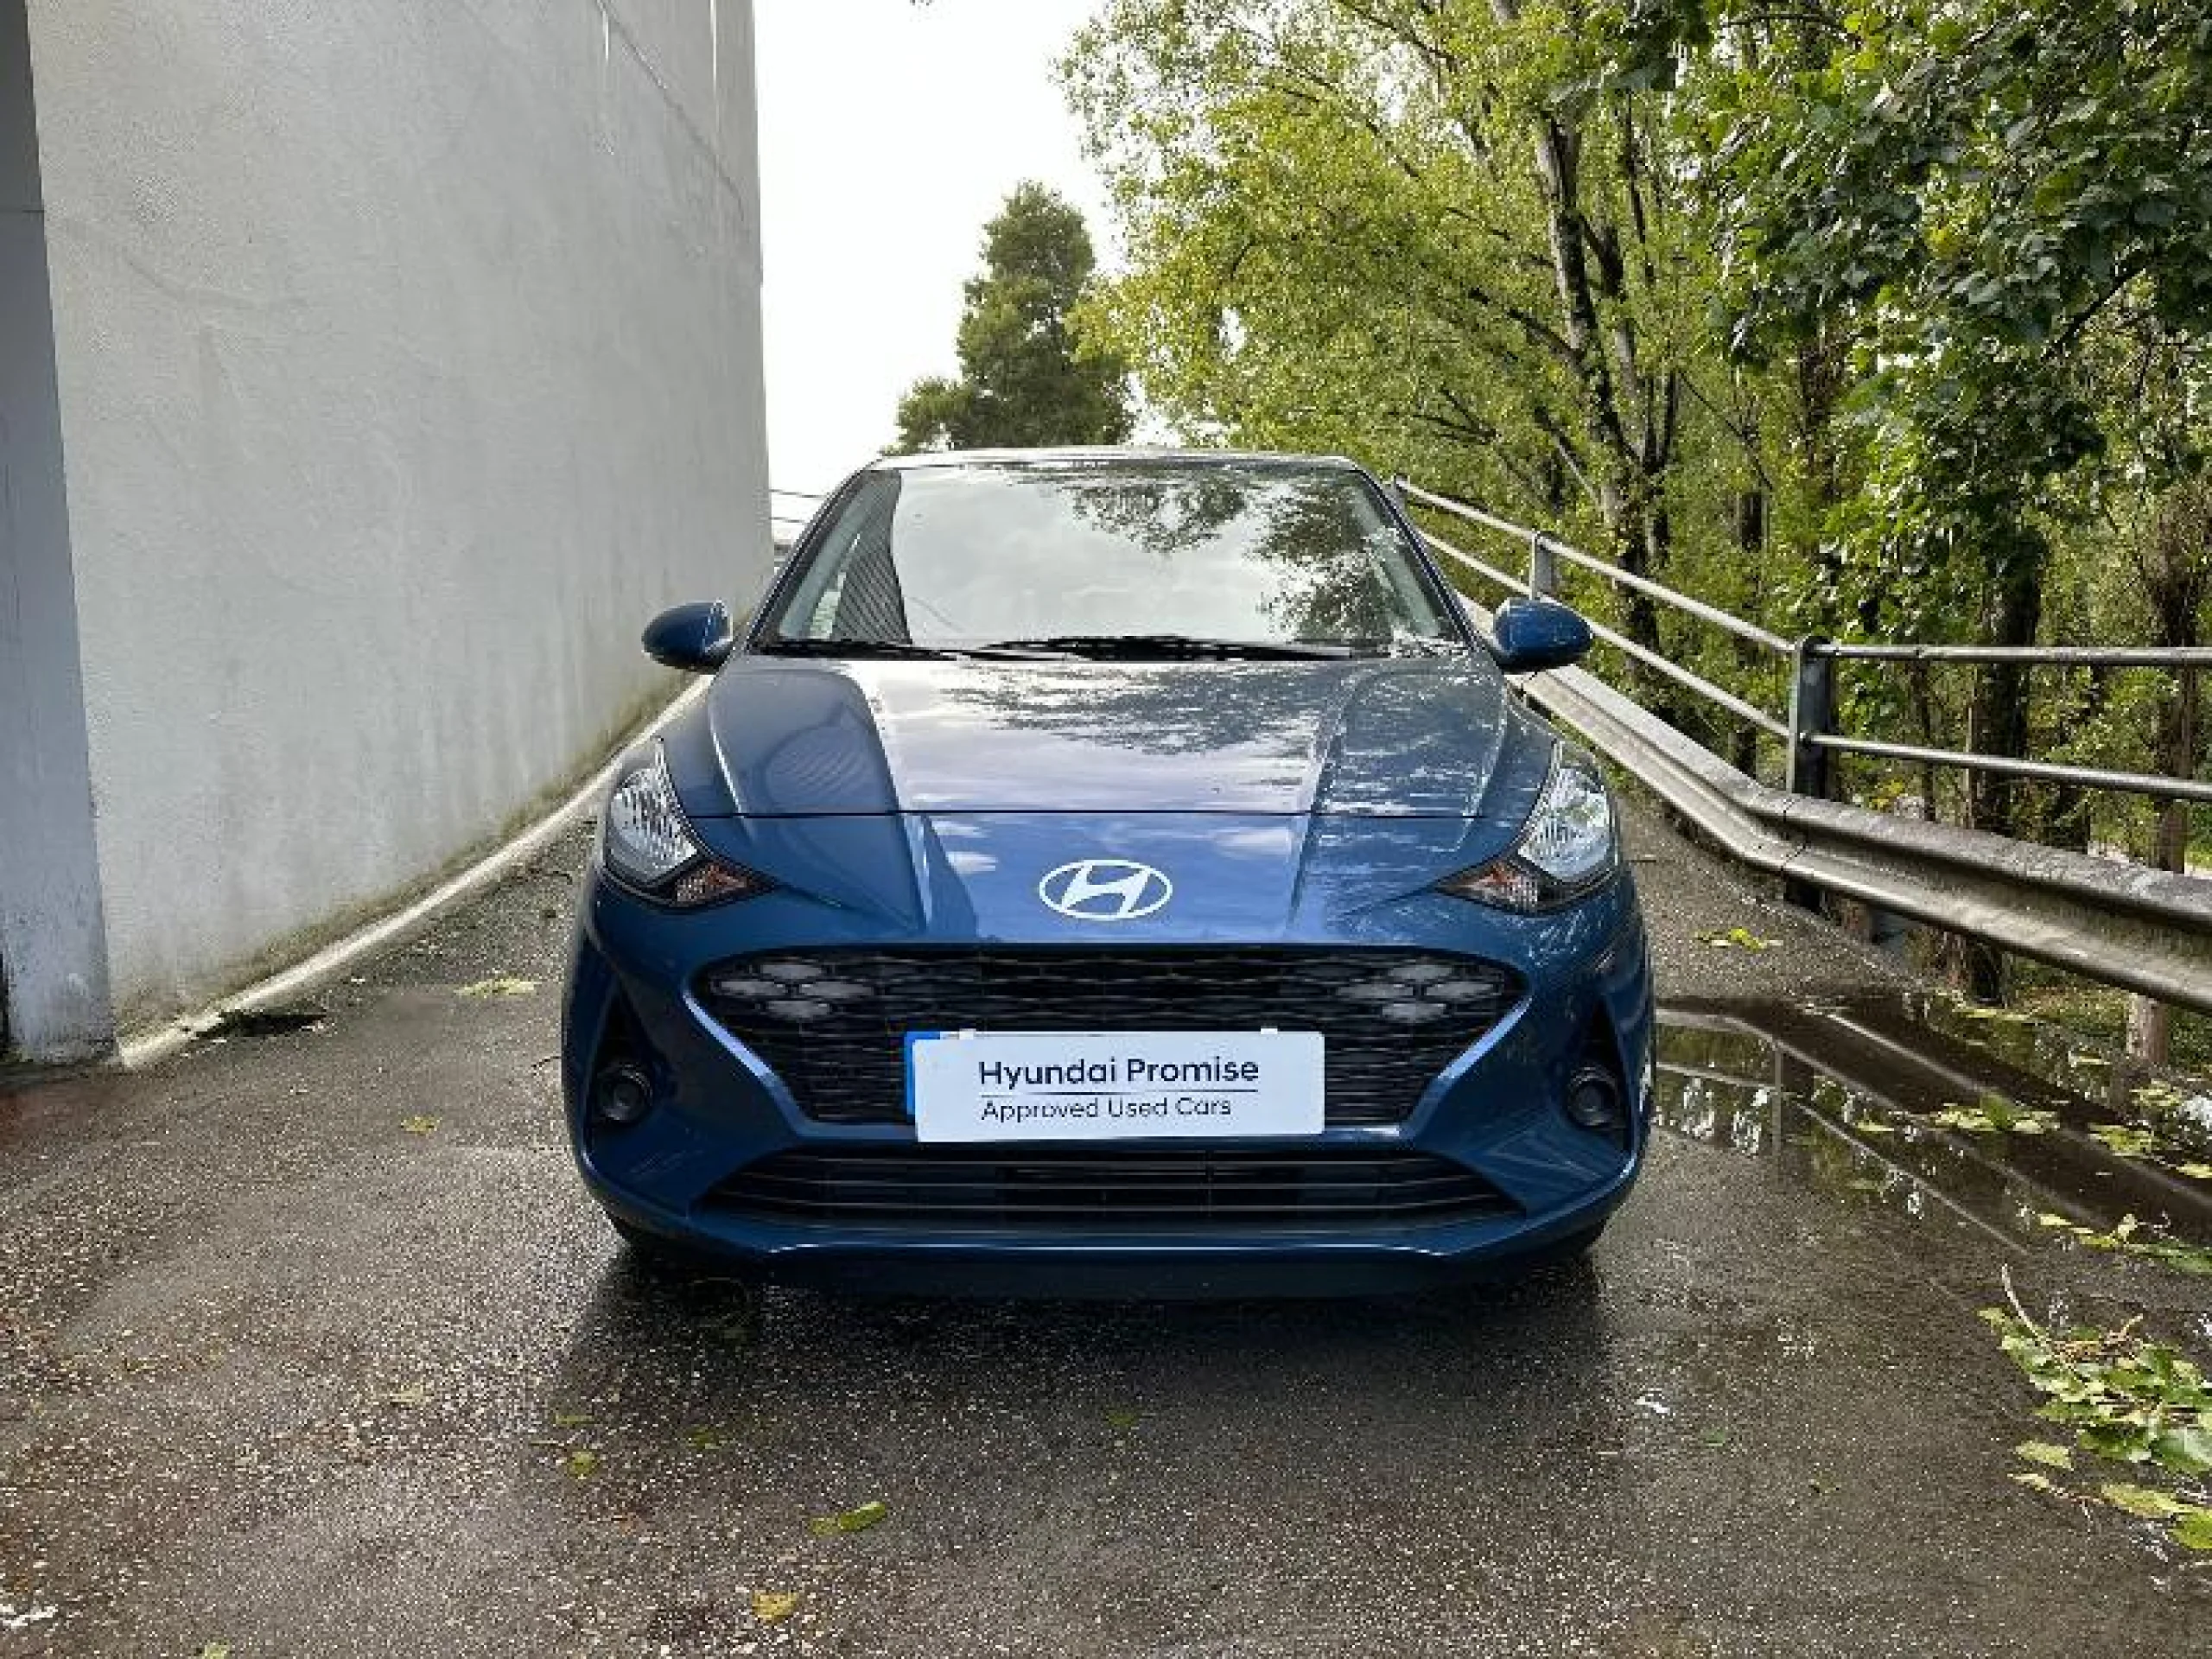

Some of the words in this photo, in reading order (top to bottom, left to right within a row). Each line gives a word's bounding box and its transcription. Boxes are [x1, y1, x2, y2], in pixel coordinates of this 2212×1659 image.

[978, 1056, 1117, 1089] Hyundai
[1126, 1055, 1260, 1083] Promise
[981, 1097, 1099, 1123] Approved
[1108, 1096, 1168, 1119] Used
[1174, 1096, 1232, 1116] Cars
